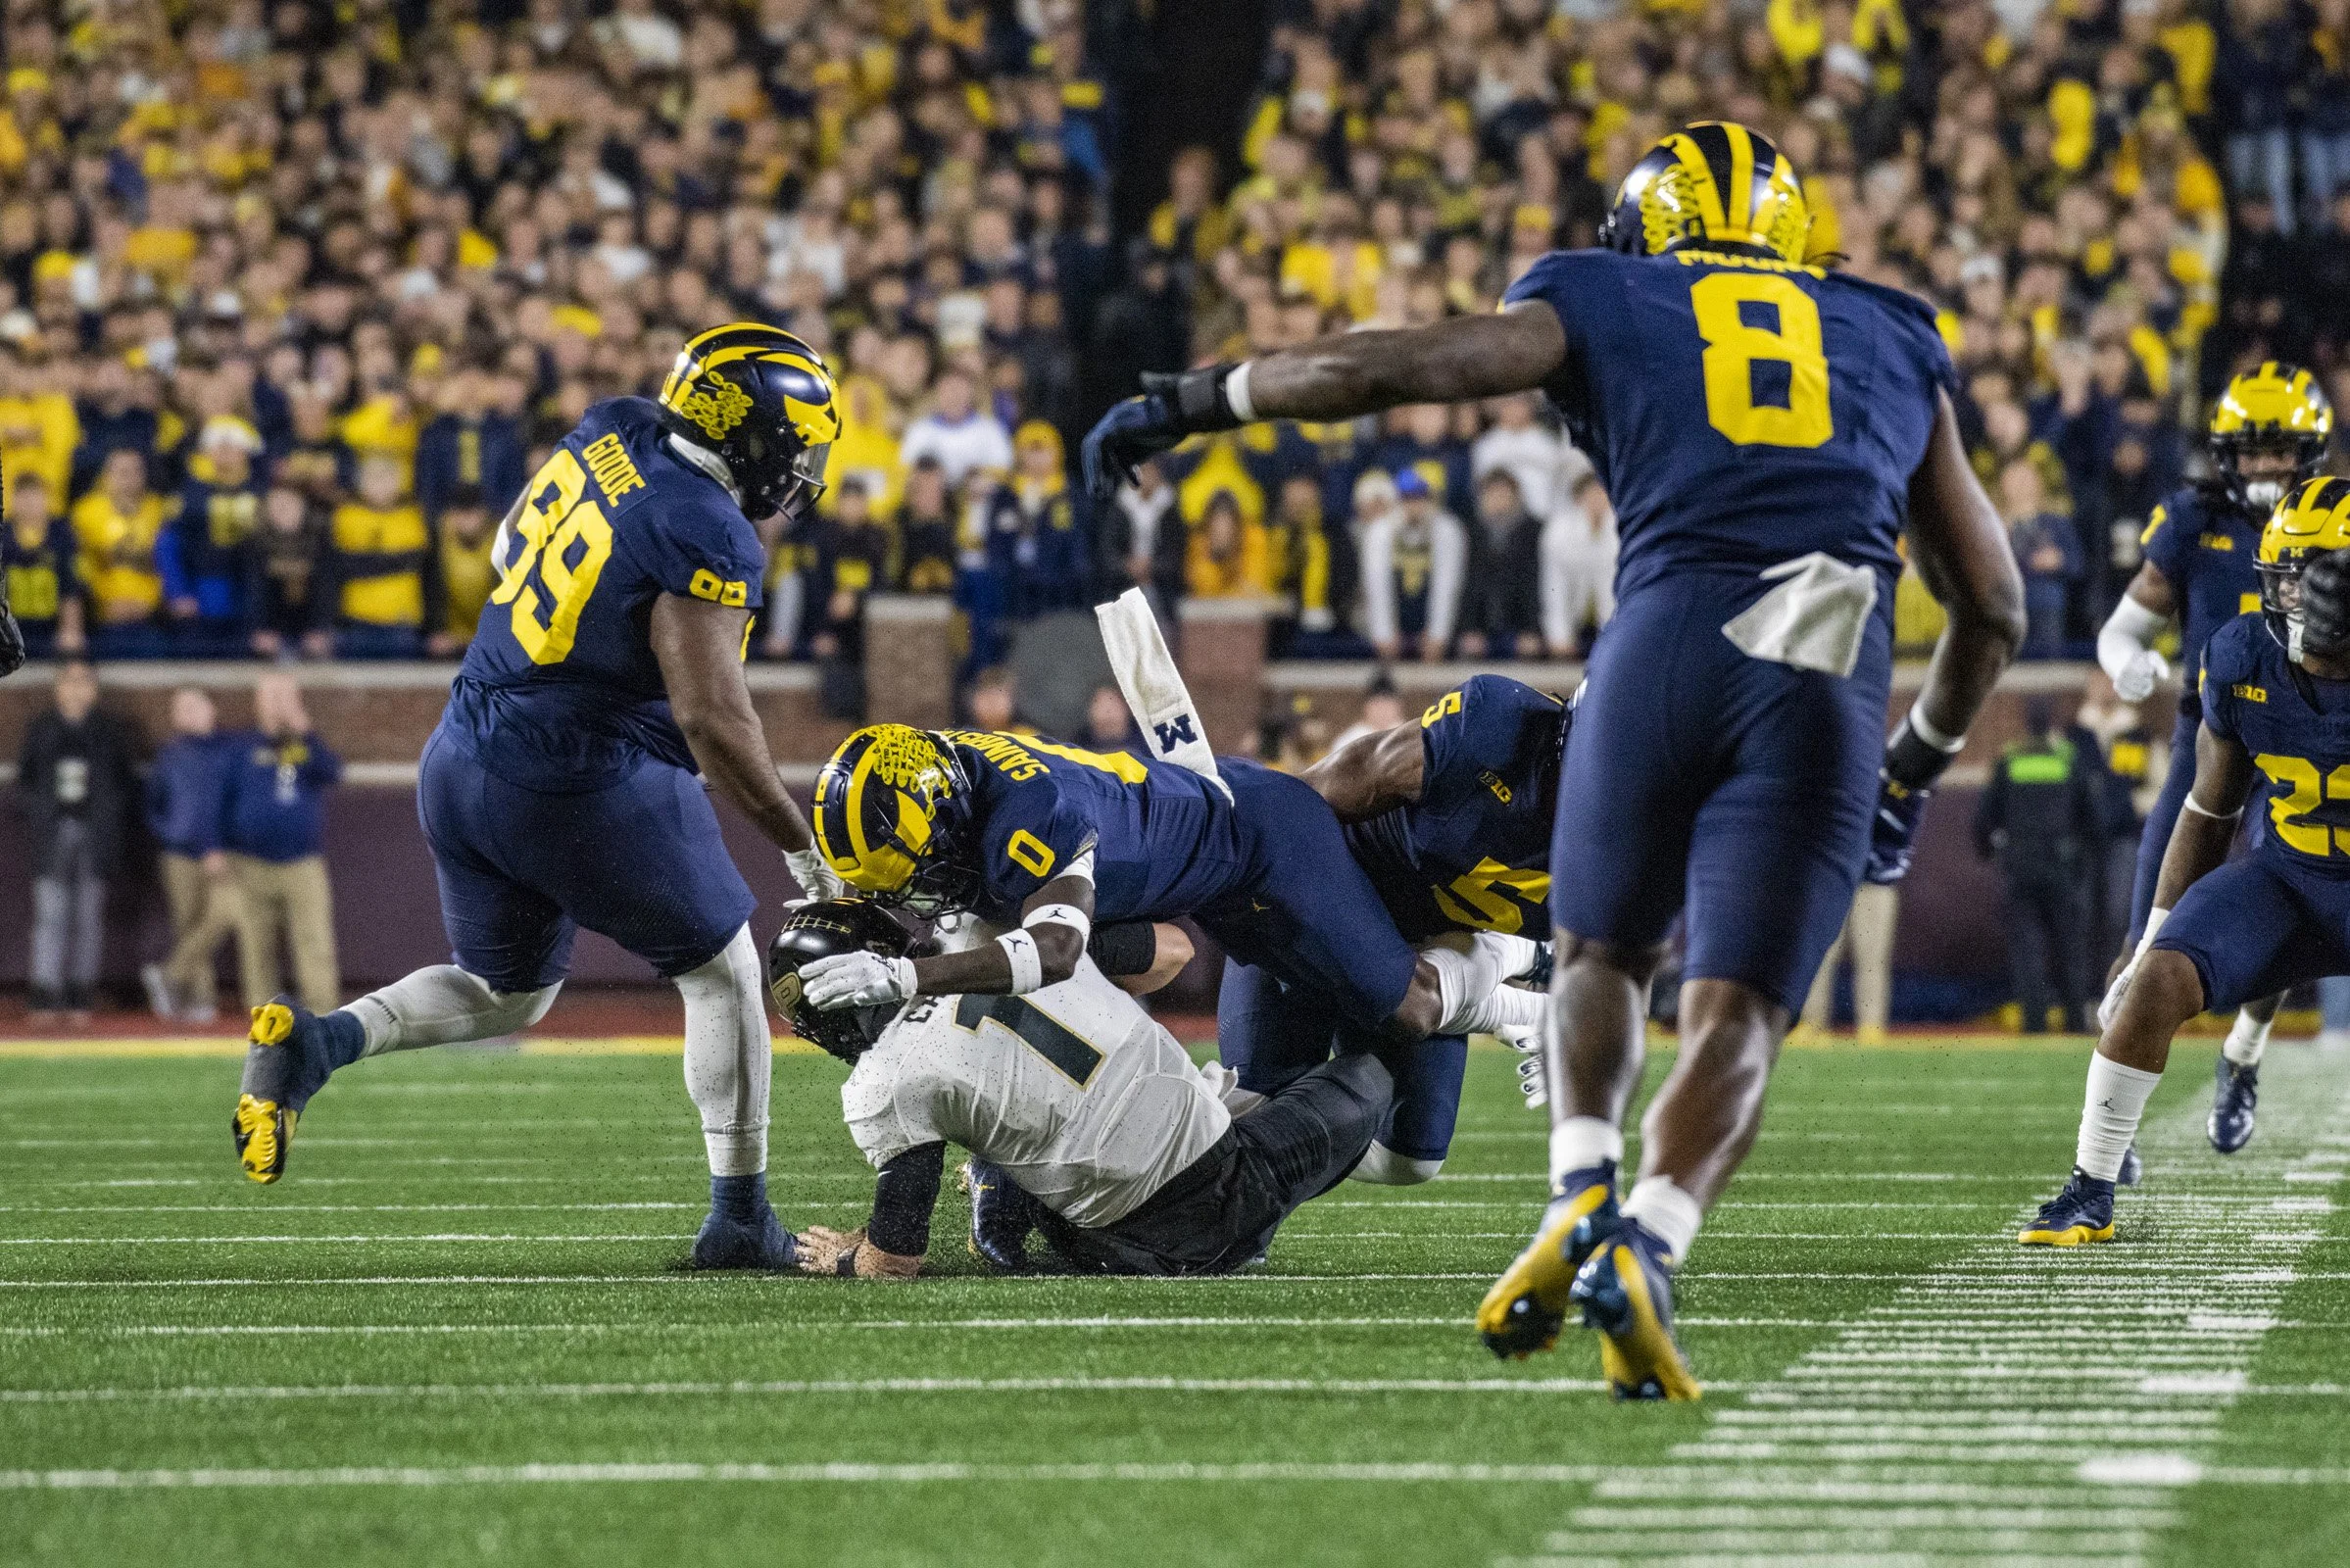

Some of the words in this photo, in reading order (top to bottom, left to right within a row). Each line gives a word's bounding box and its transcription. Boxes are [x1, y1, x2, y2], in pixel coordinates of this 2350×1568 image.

[1689, 272, 1835, 449] 8
[582, 432, 646, 508] GOODE
[1153, 713, 1199, 755] M
[1422, 691, 1462, 728] 5
[1008, 829, 1055, 878] 0
[1430, 856, 1552, 935] 5
[952, 994, 1107, 1092] 1
